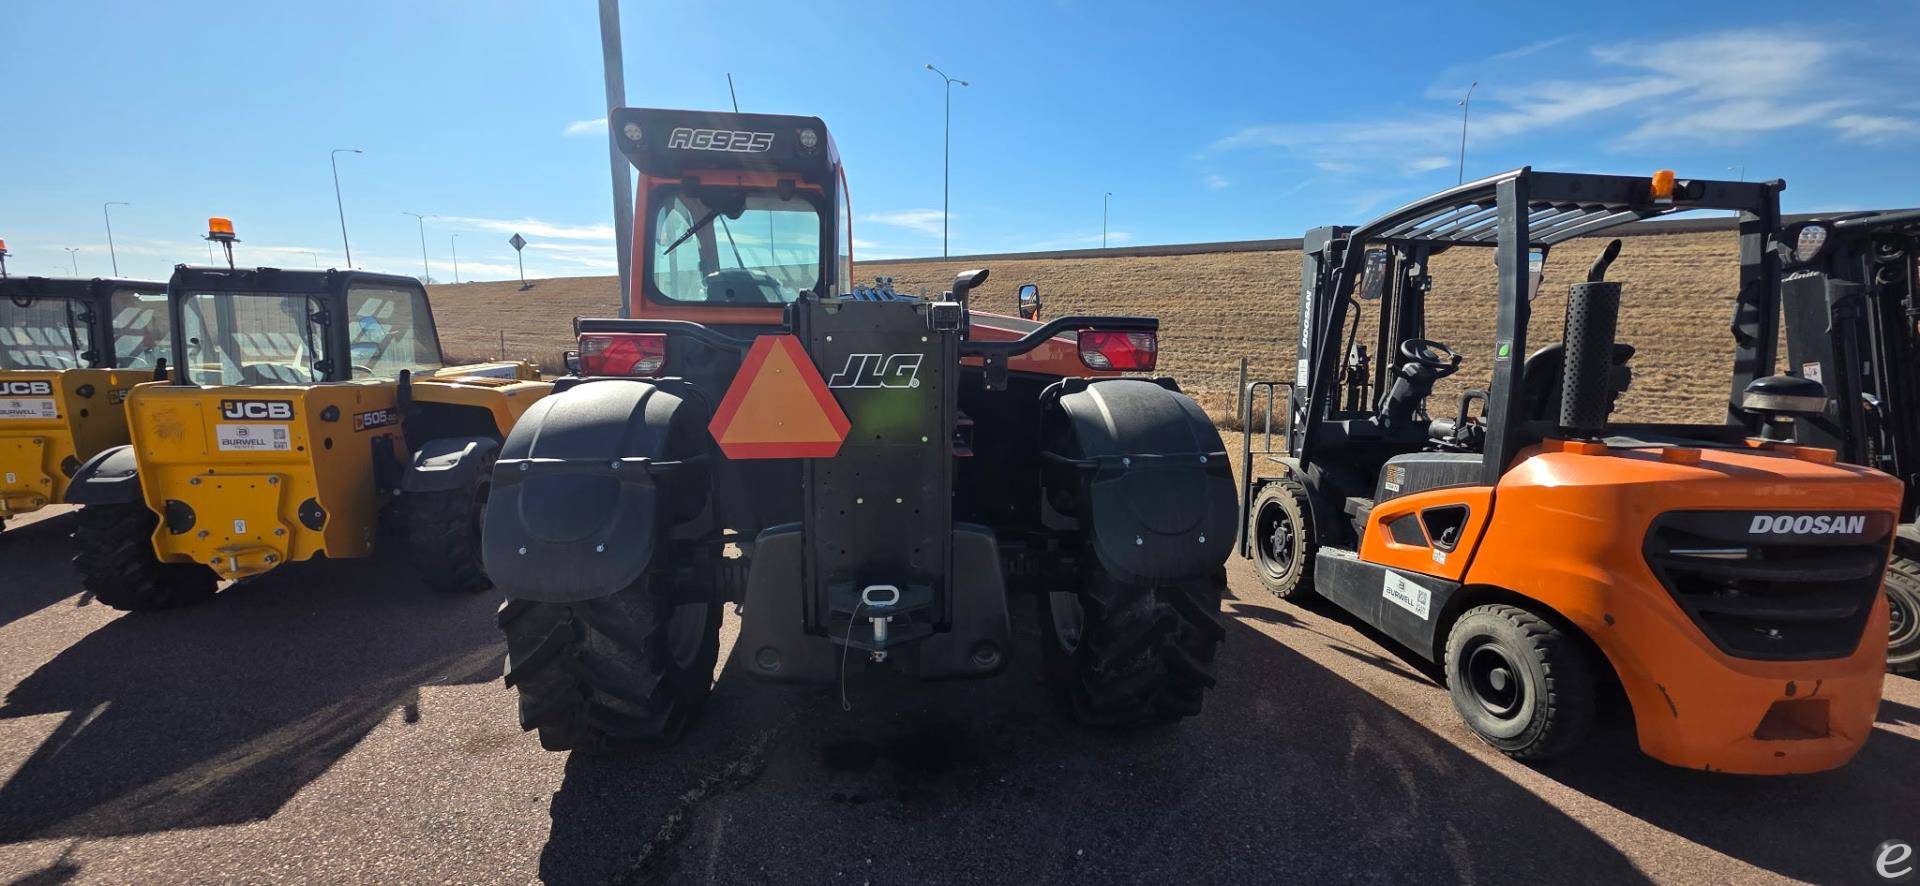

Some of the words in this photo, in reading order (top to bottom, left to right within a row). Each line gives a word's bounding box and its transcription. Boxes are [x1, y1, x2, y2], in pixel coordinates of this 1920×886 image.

[668, 127, 775, 152] AG925
[1302, 290, 1312, 348] DOOSAN
[828, 353, 924, 389] JLG
[0, 382, 51, 395] JCB
[224, 402, 292, 418] JCB
[222, 438, 266, 446] BURWELL
[1749, 515, 1866, 534] DOOSAN
[1386, 586, 1415, 607] BURWELL
